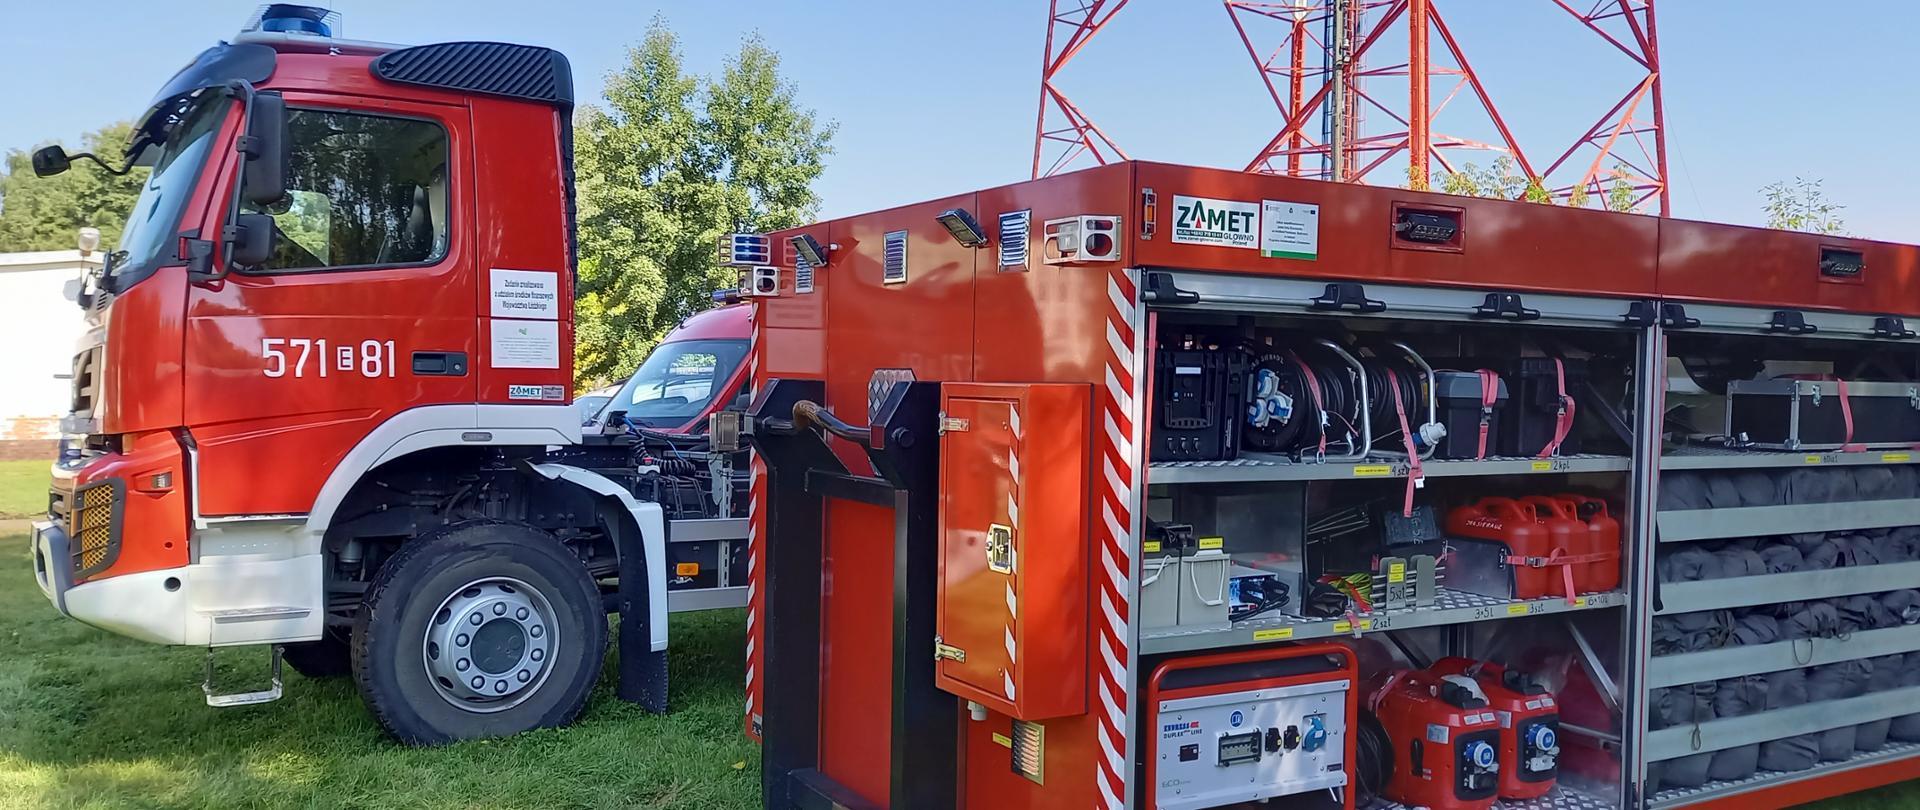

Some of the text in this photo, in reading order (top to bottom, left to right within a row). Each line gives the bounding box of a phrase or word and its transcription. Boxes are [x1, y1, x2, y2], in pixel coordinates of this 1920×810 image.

[1177, 200, 1255, 233] ZAMET
[262, 338, 395, 378] 571 E 81
[510, 386, 541, 395] ZAMET
